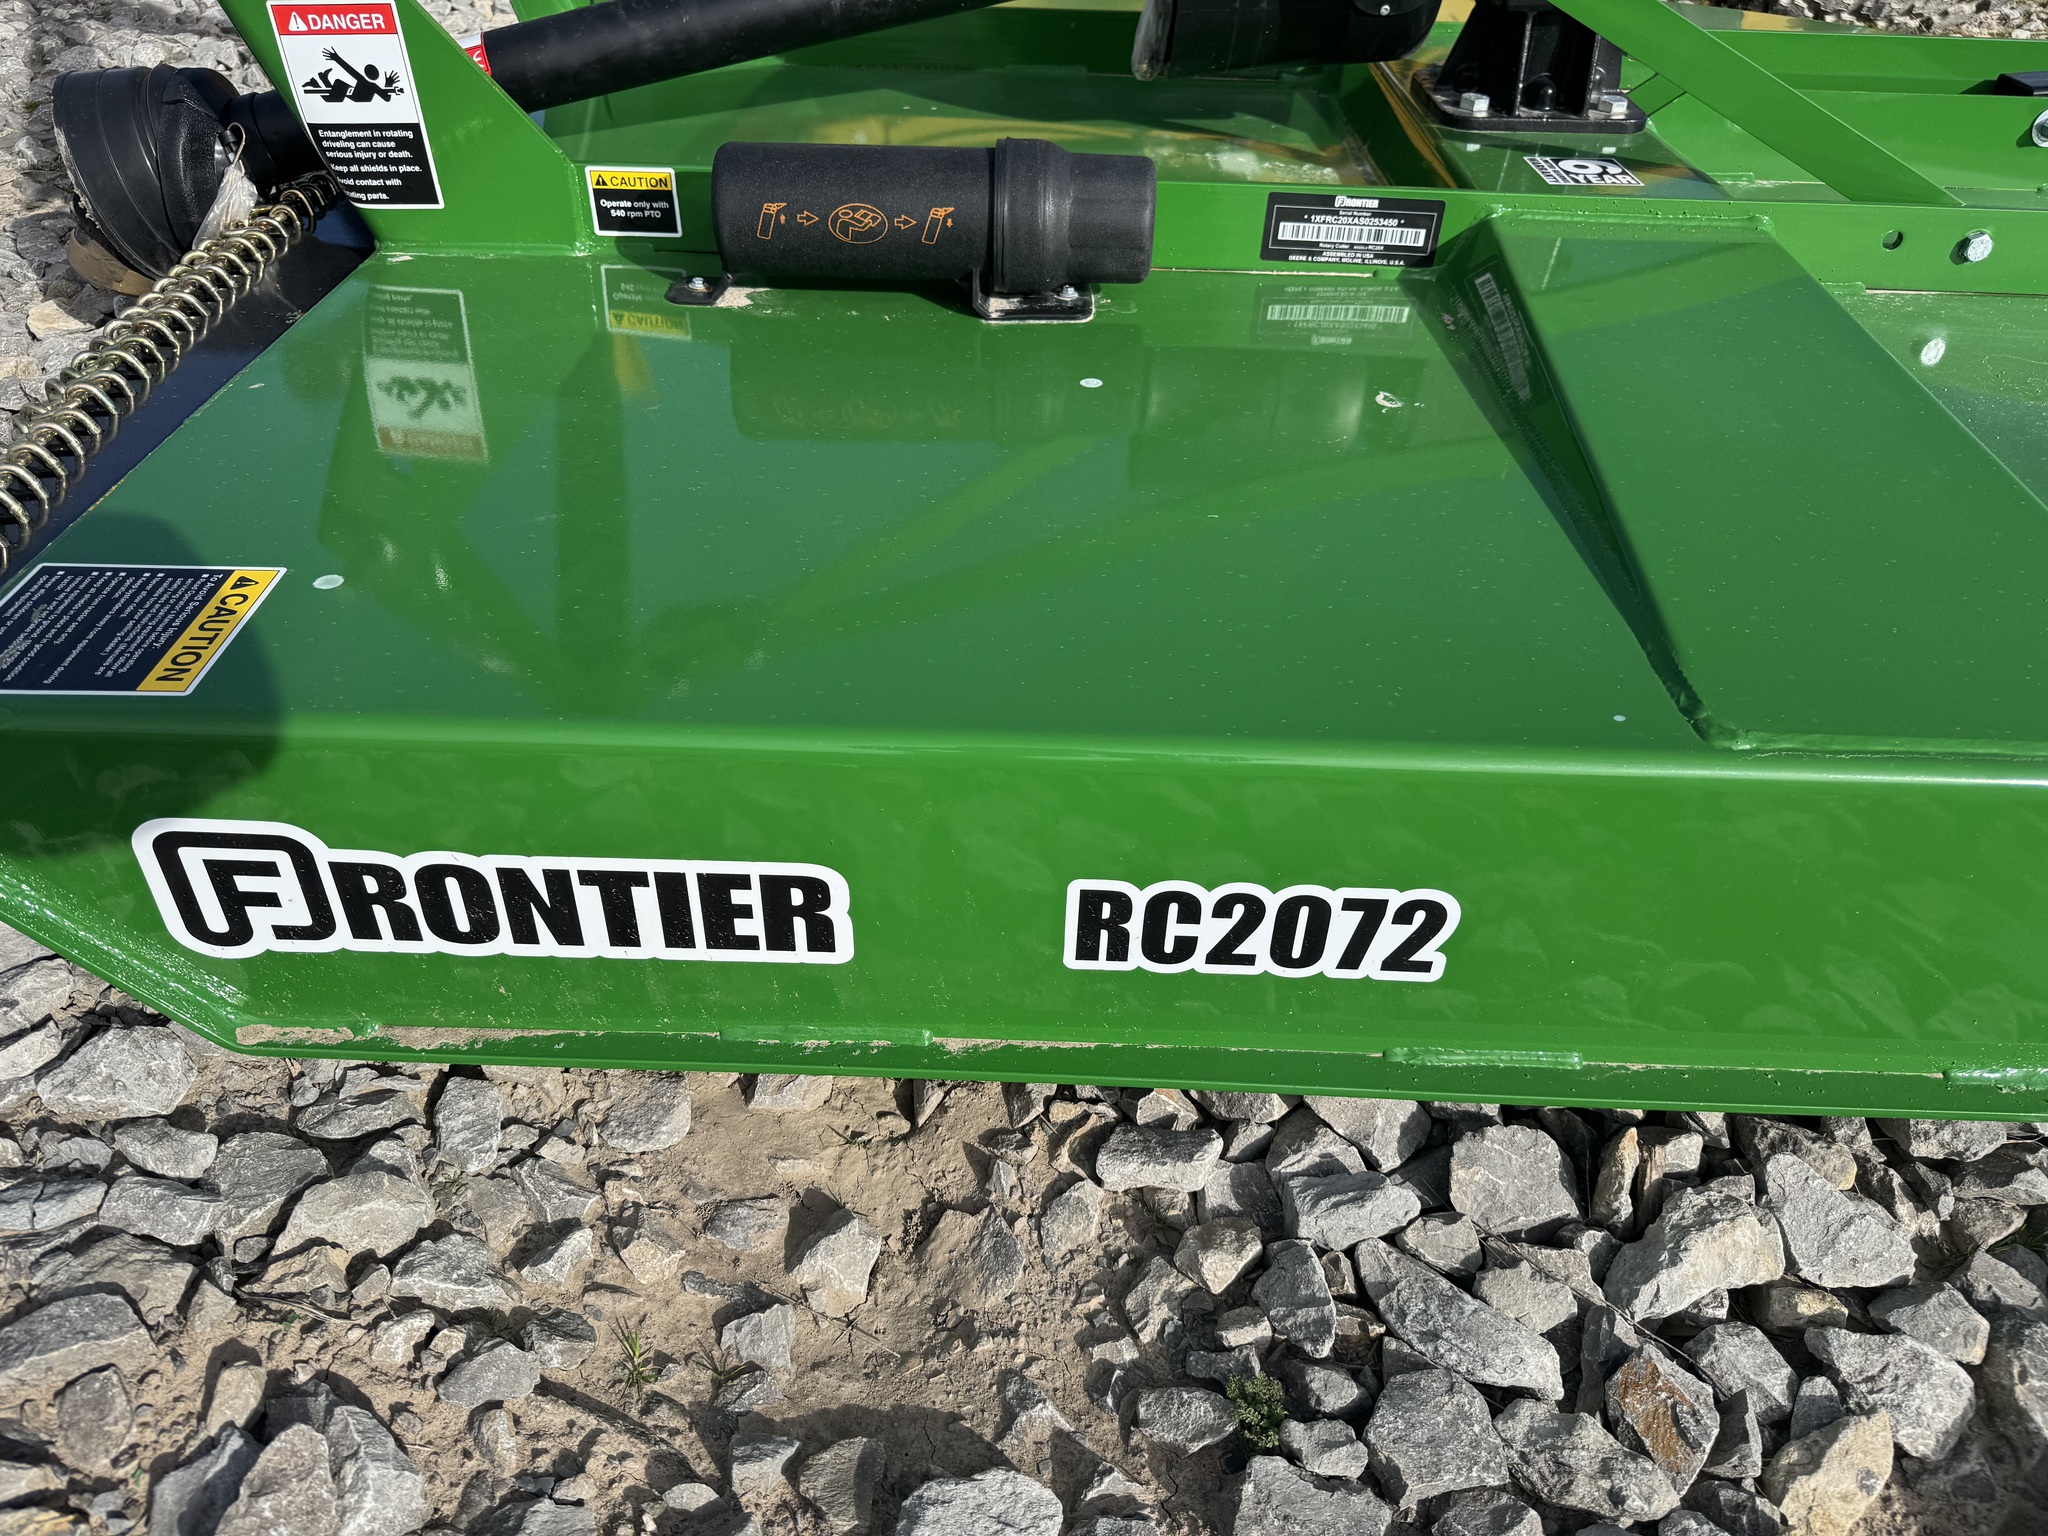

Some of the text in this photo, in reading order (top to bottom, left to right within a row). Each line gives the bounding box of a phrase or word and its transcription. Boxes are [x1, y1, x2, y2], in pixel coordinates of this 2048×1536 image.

[307, 14, 386, 31] DANGER
[318, 130, 414, 139] Entanglement in rotating
[354, 150, 377, 160] injury
[388, 150, 414, 158] death.
[349, 164, 359, 172] all
[398, 165, 423, 173] place.
[355, 178, 385, 186] contact
[385, 178, 402, 186] with
[610, 176, 669, 188] CAUTION
[1570, 174, 1637, 185] YEAR
[367, 192, 390, 200] parts.
[600, 199, 669, 209] Operate only with
[1334, 195, 1380, 209] FRONTIER
[610, 209, 661, 219] 540 rpm PTO
[1310, 214, 1399, 227] 1XFRC20XAS0253450
[152, 574, 223, 649] To Avoid Serious Injury:
[155, 592, 249, 682] CAUTION
[152, 830, 837, 953] FRONTIER
[1075, 888, 1448, 974] RC2072
